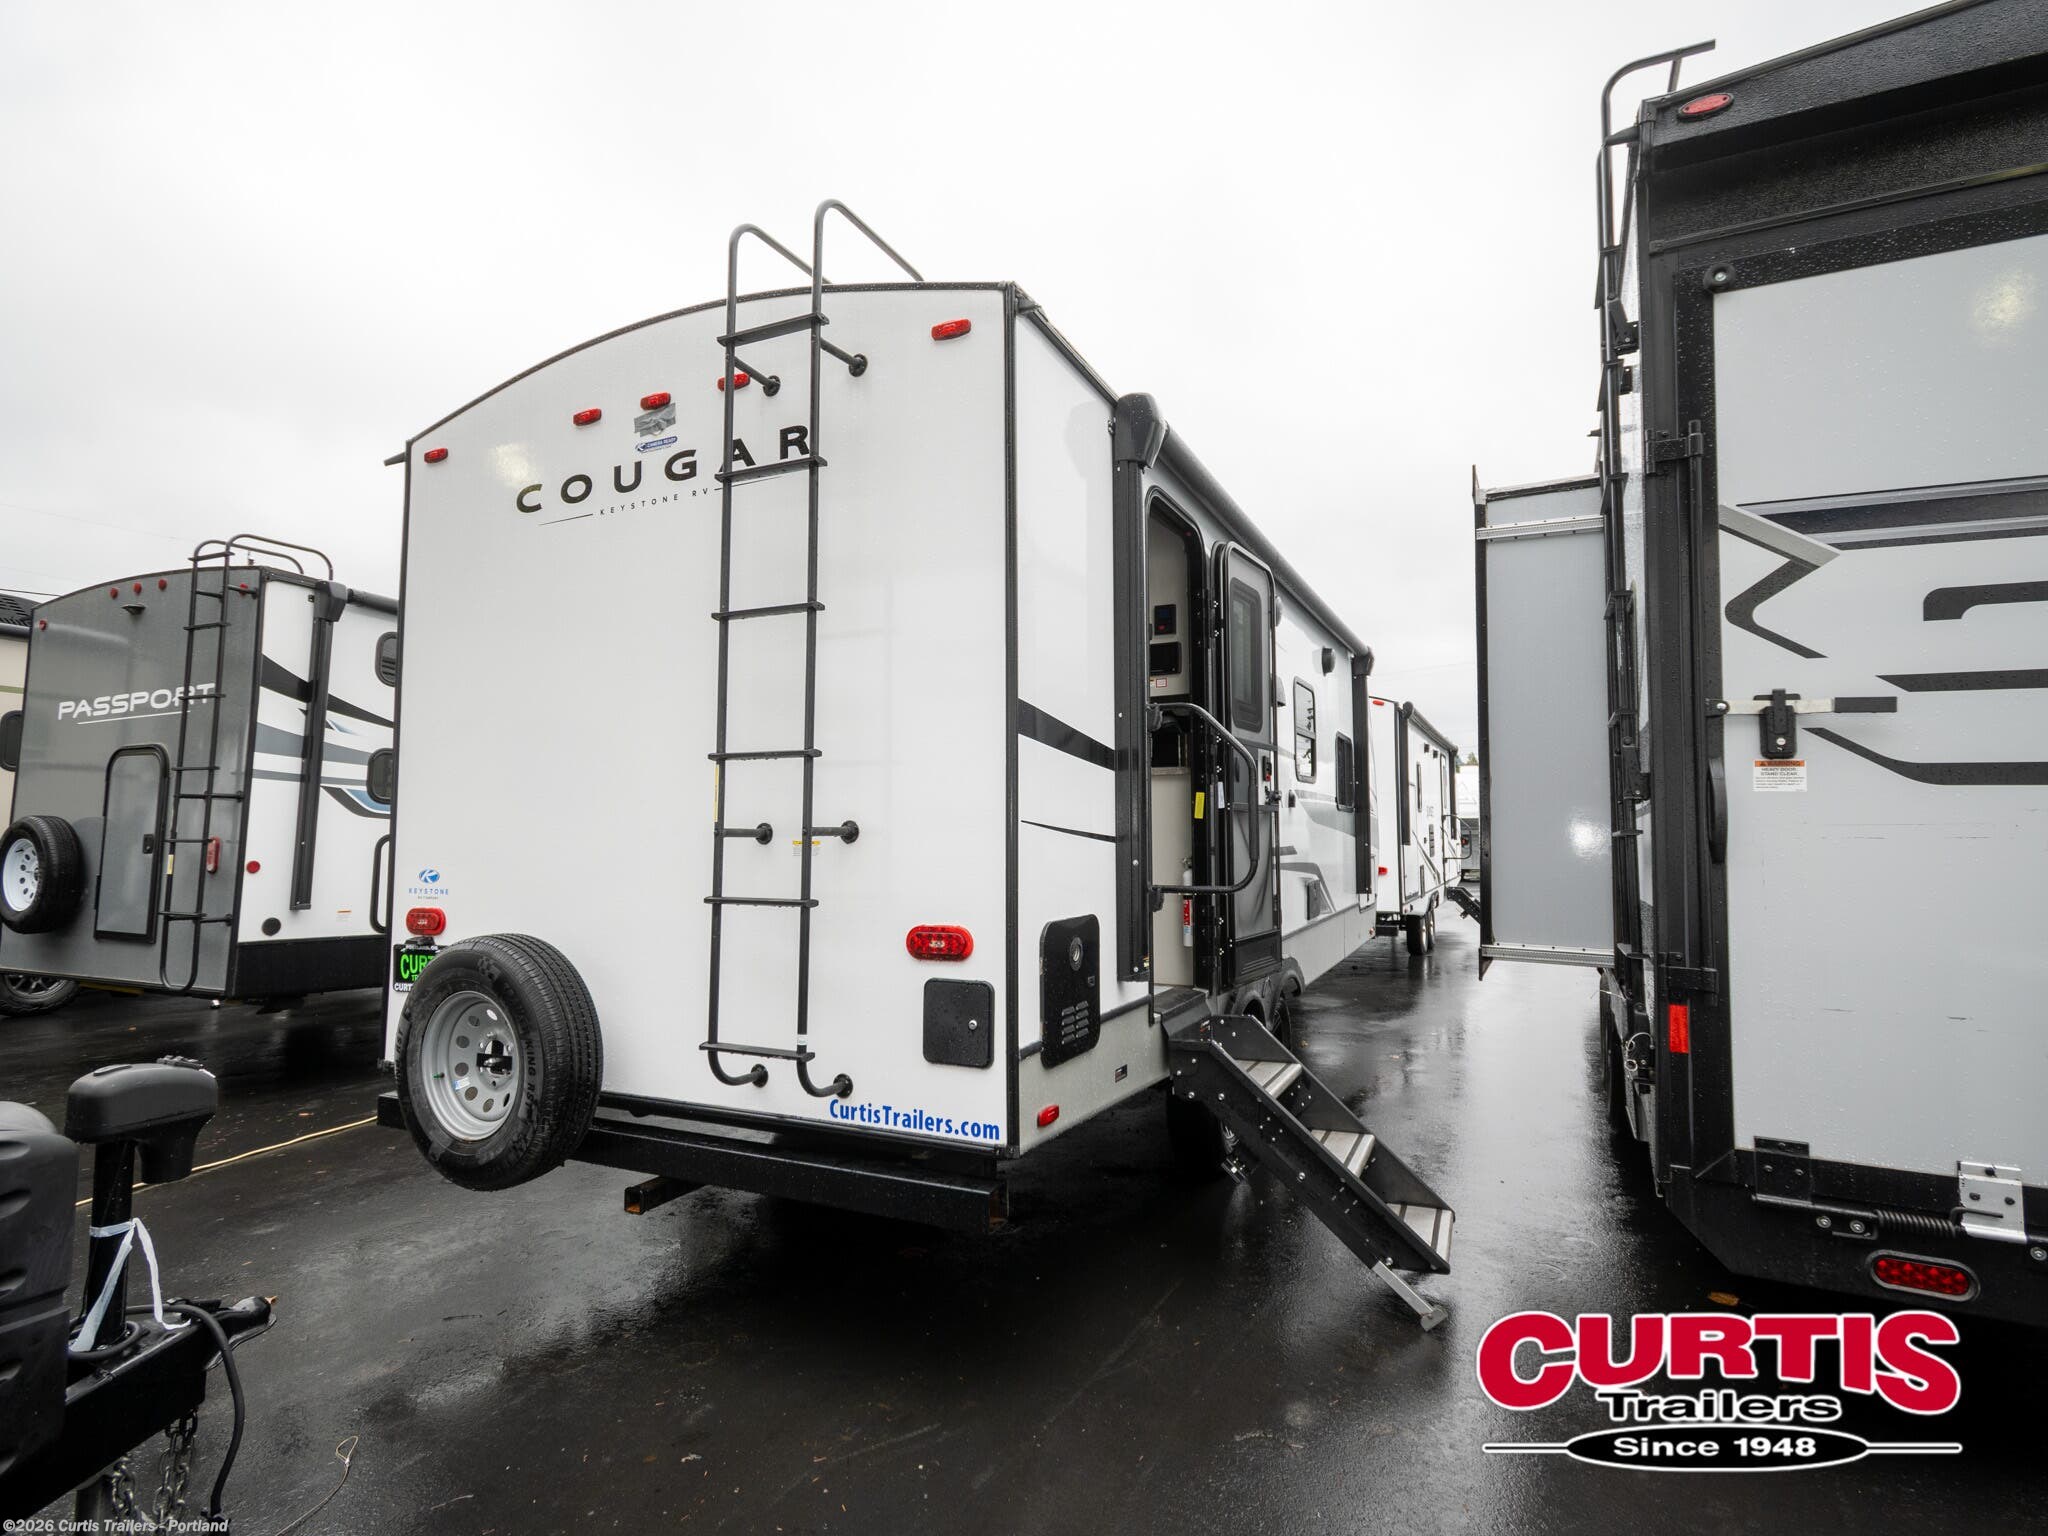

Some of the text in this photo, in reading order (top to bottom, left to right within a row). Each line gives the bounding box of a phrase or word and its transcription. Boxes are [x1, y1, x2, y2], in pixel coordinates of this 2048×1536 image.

[516, 425, 810, 513] COUGAR
[600, 487, 709, 516] KEYSTONE RV
[57, 683, 216, 721] PASSPORT
[408, 887, 449, 896] KEYSTONE
[829, 1099, 1000, 1140] CurtisTrailers.com
